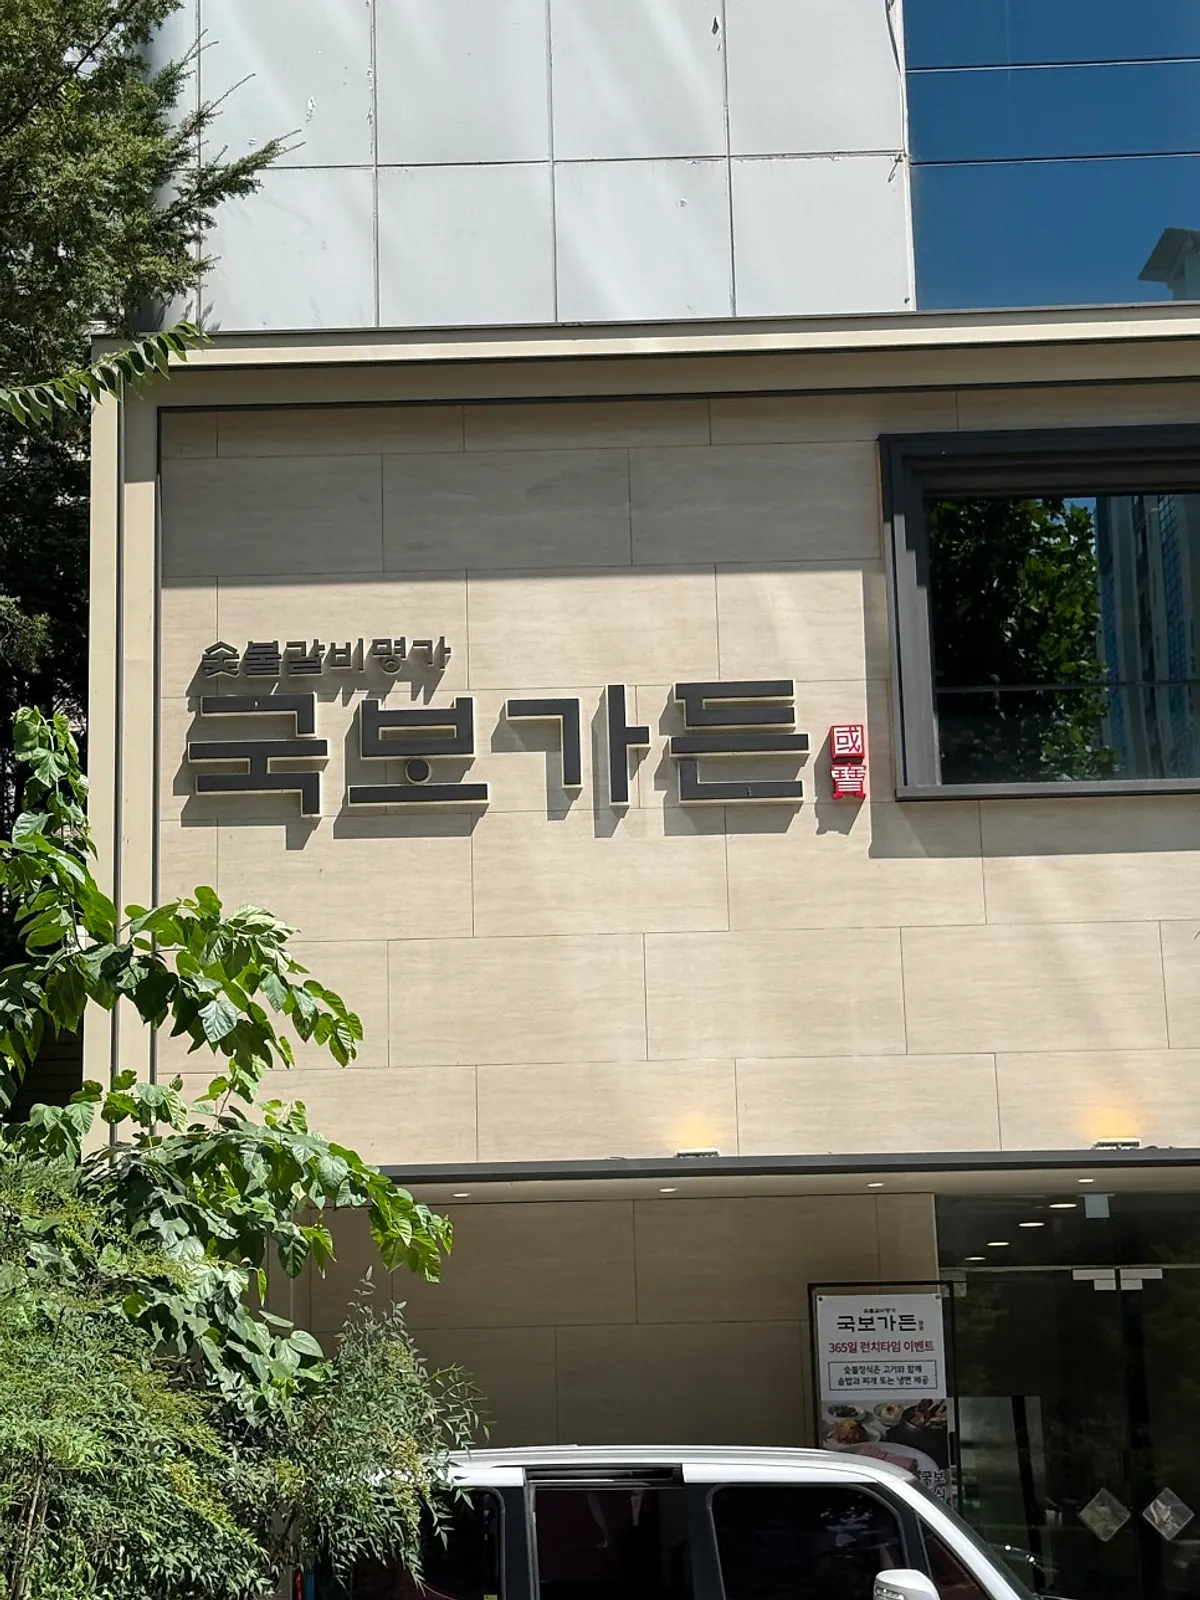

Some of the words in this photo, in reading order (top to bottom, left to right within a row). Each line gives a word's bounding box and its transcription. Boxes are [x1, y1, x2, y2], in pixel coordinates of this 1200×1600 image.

[203, 636, 452, 678] 숯불갈비명가
[188, 680, 809, 818] 국보가든
[837, 1314, 917, 1333] 국보가든
[828, 1341, 857, 1353] 365일
[860, 1340, 901, 1353] 런치타임
[903, 1340, 935, 1353] 이벤트
[883, 1365, 905, 1374] 고기와
[879, 1376, 895, 1386] 또는
